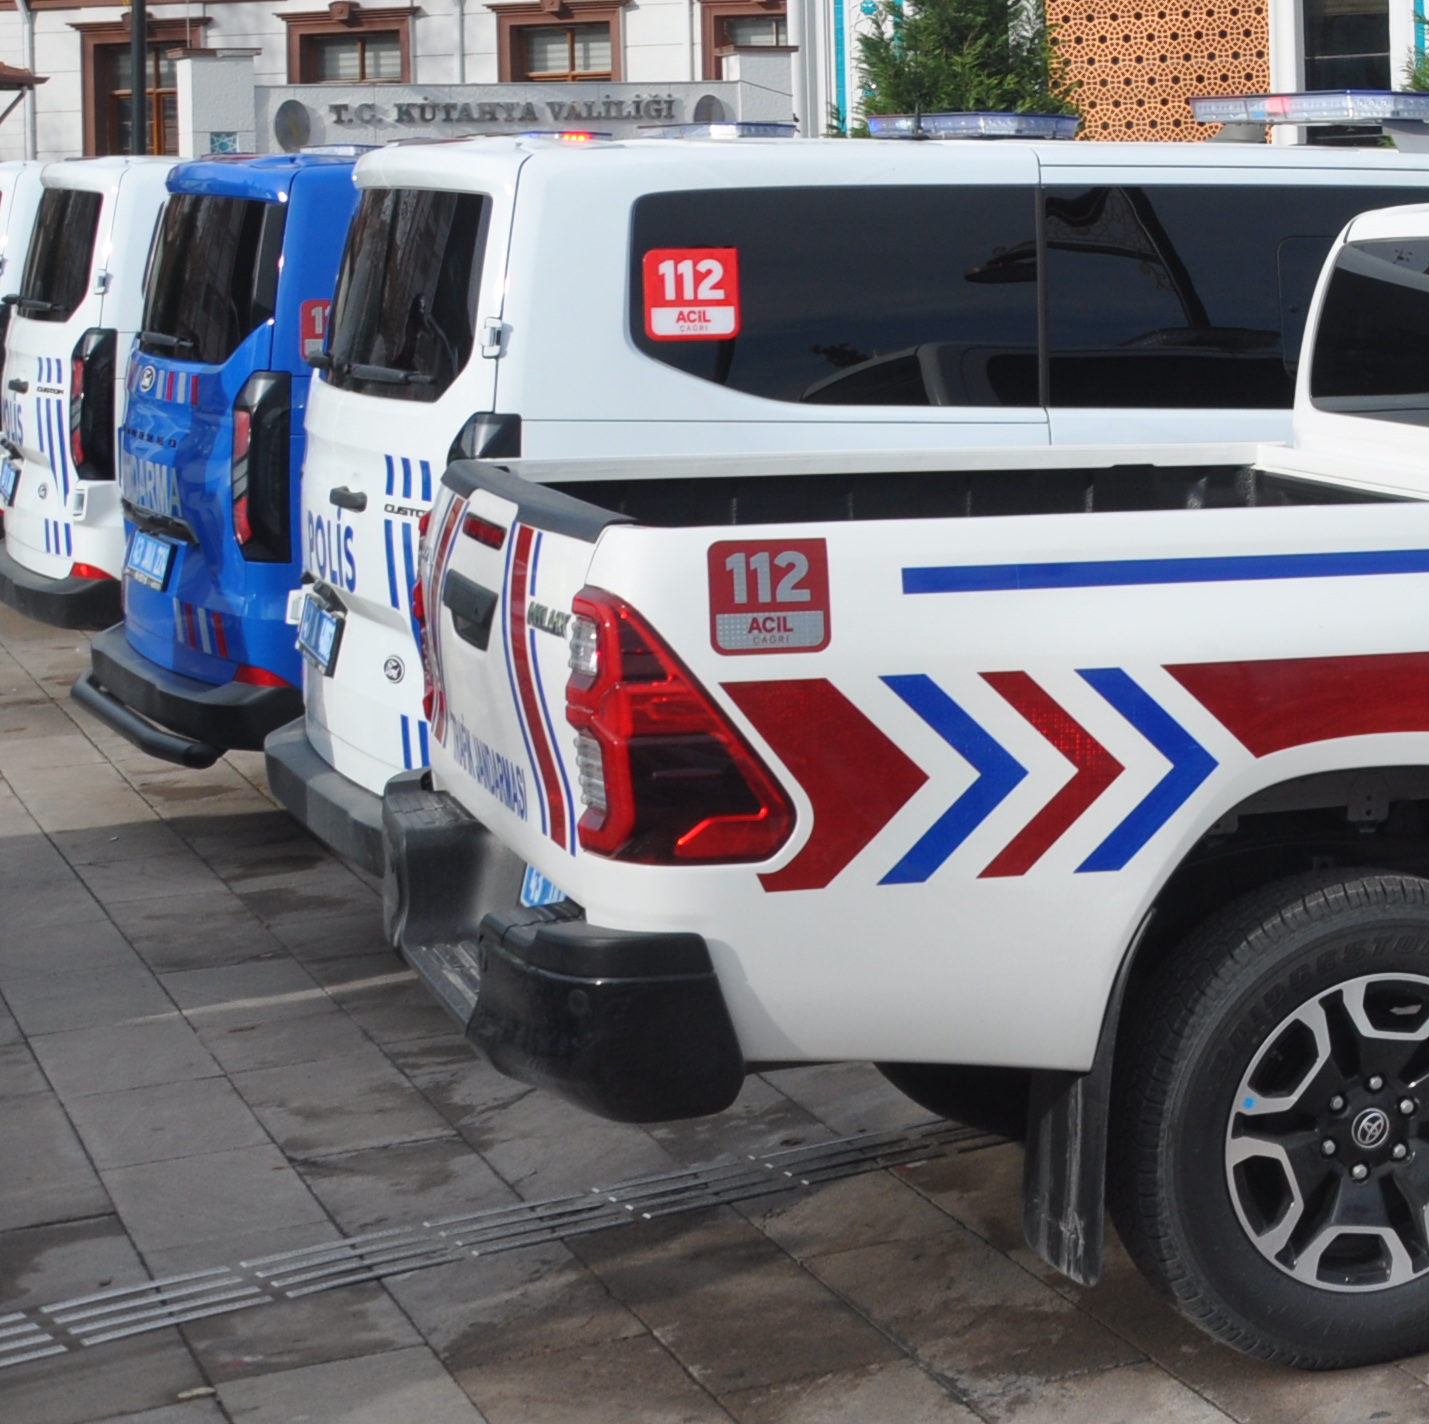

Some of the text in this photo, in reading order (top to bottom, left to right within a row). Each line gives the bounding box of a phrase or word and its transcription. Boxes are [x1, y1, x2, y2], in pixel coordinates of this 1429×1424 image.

[328, 93, 676, 125] T.C. KÜTAHYA VALİLİĞİ
[657, 258, 726, 301] 112
[675, 310, 712, 324] ACİL
[383, 503, 430, 519] CUSTO
[308, 506, 356, 594] POLİS
[725, 550, 812, 605] 112
[748, 616, 794, 634] ACİL
